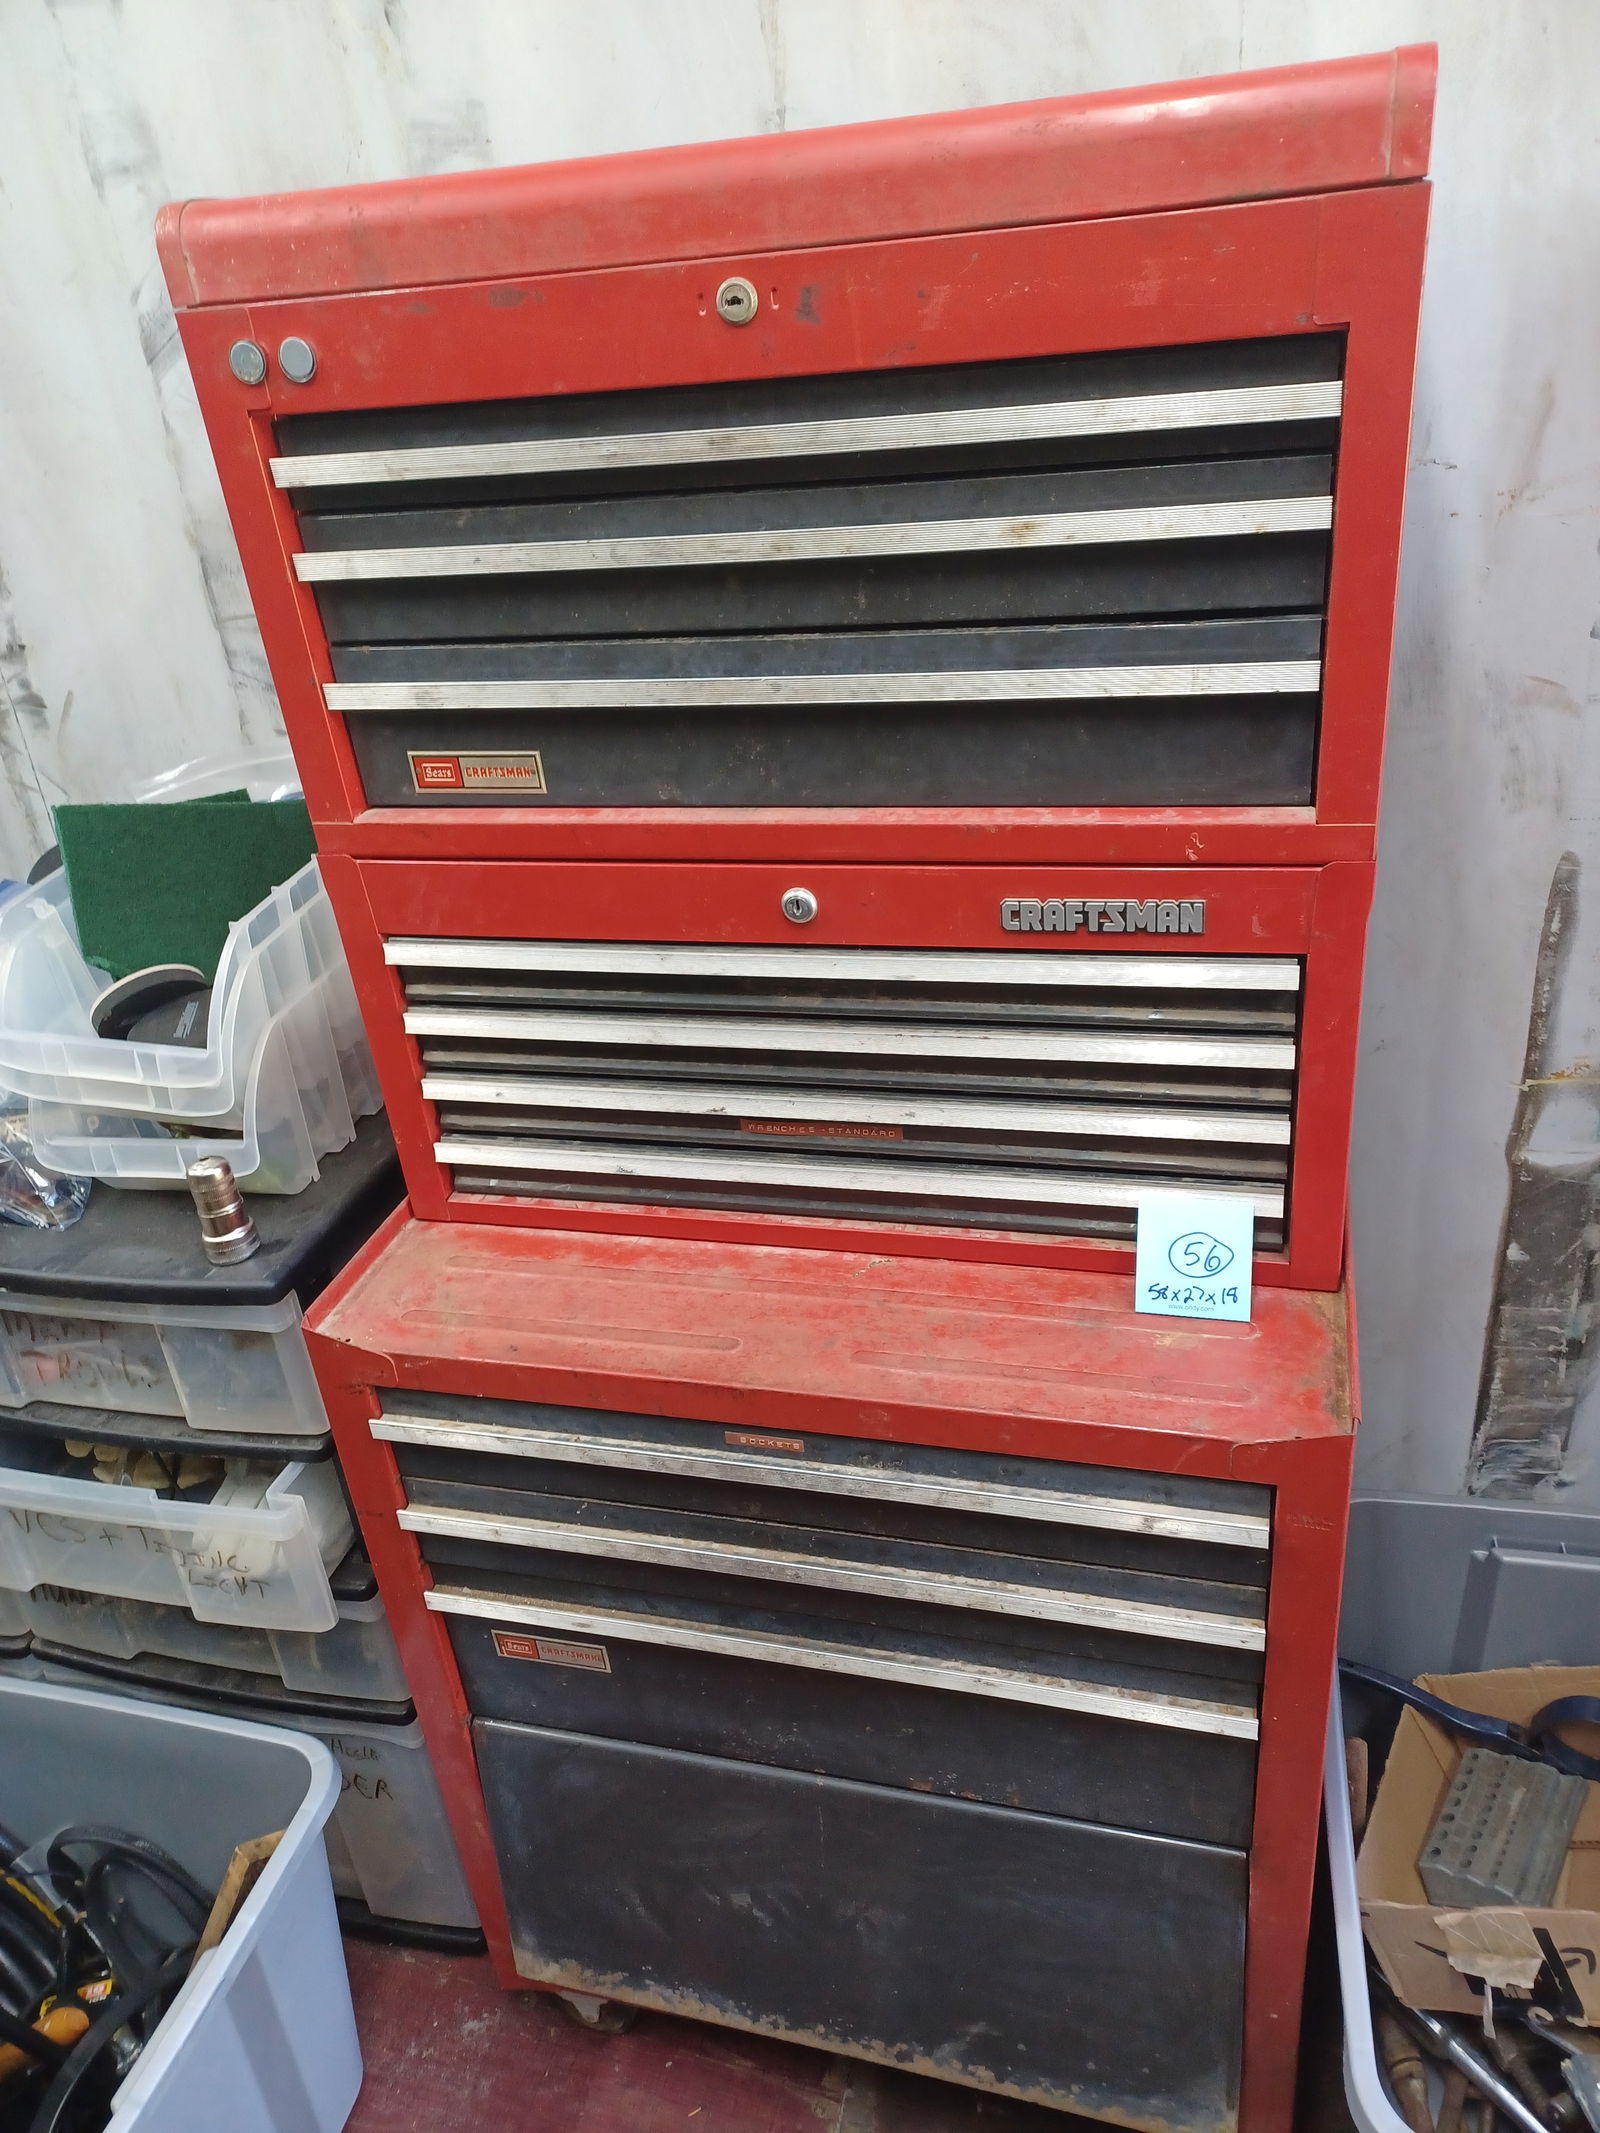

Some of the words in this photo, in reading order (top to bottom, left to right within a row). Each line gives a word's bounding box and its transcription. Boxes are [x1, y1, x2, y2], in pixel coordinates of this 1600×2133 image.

[425, 767, 452, 778] Sears
[465, 767, 531, 778] CRAFTSMAN
[1001, 898, 1206, 934] CRAFTSMAN
[1184, 1241, 1221, 1272] 56
[740, 1436, 800, 1450] SOCKETS
[541, 1647, 598, 1662] CRAFTSMAN
